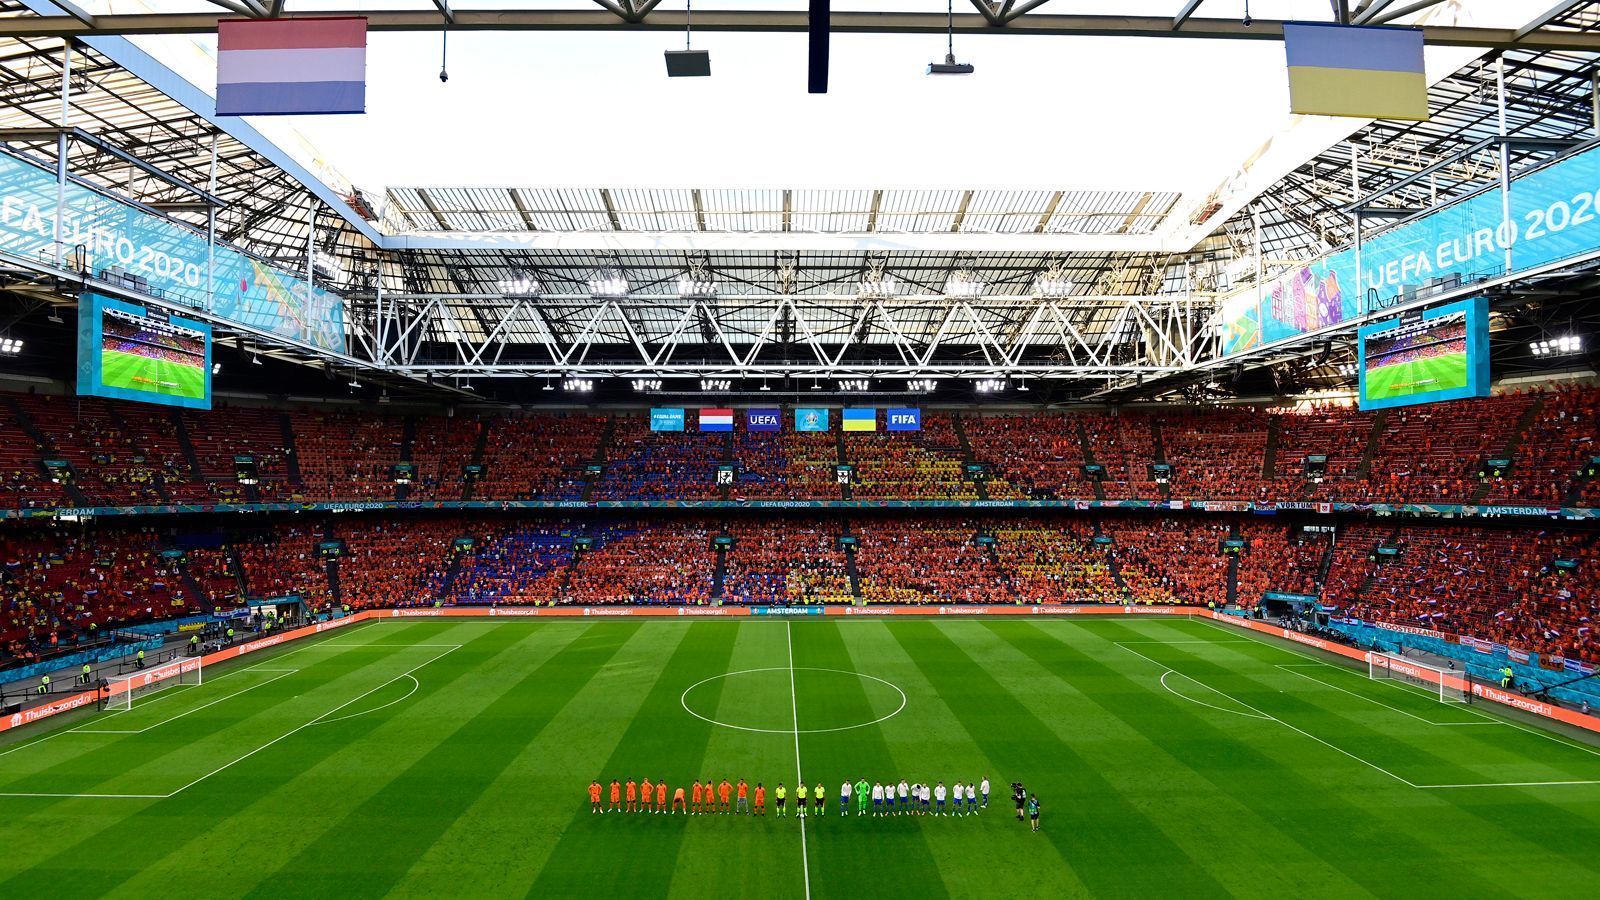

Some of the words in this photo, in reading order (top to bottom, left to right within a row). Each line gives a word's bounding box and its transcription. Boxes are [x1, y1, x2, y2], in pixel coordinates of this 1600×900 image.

[1368, 250, 1433, 289] UEFA
[1436, 219, 1519, 269] EURO
[1524, 187, 1600, 240] 202
[138, 245, 201, 287] 2020
[750, 415, 777, 425] UEFA
[891, 414, 916, 424] FIFA
[1280, 501, 1313, 509] VORTUM
[1486, 505, 1547, 515] AMSTERDAM
[686, 607, 728, 615] Thuisbezorgd.nl
[853, 607, 895, 615] Thuisbezorgd.nl
[947, 607, 988, 615] Thuisbezorgd.nl
[1133, 606, 1175, 614] Thuisbezorgd.nl
[1376, 621, 1444, 639] KLOOSTERZANDE
[1485, 686, 1552, 716] Thuisbezorgd.nl
[25, 693, 91, 721] Thuisbezorgd.nl
